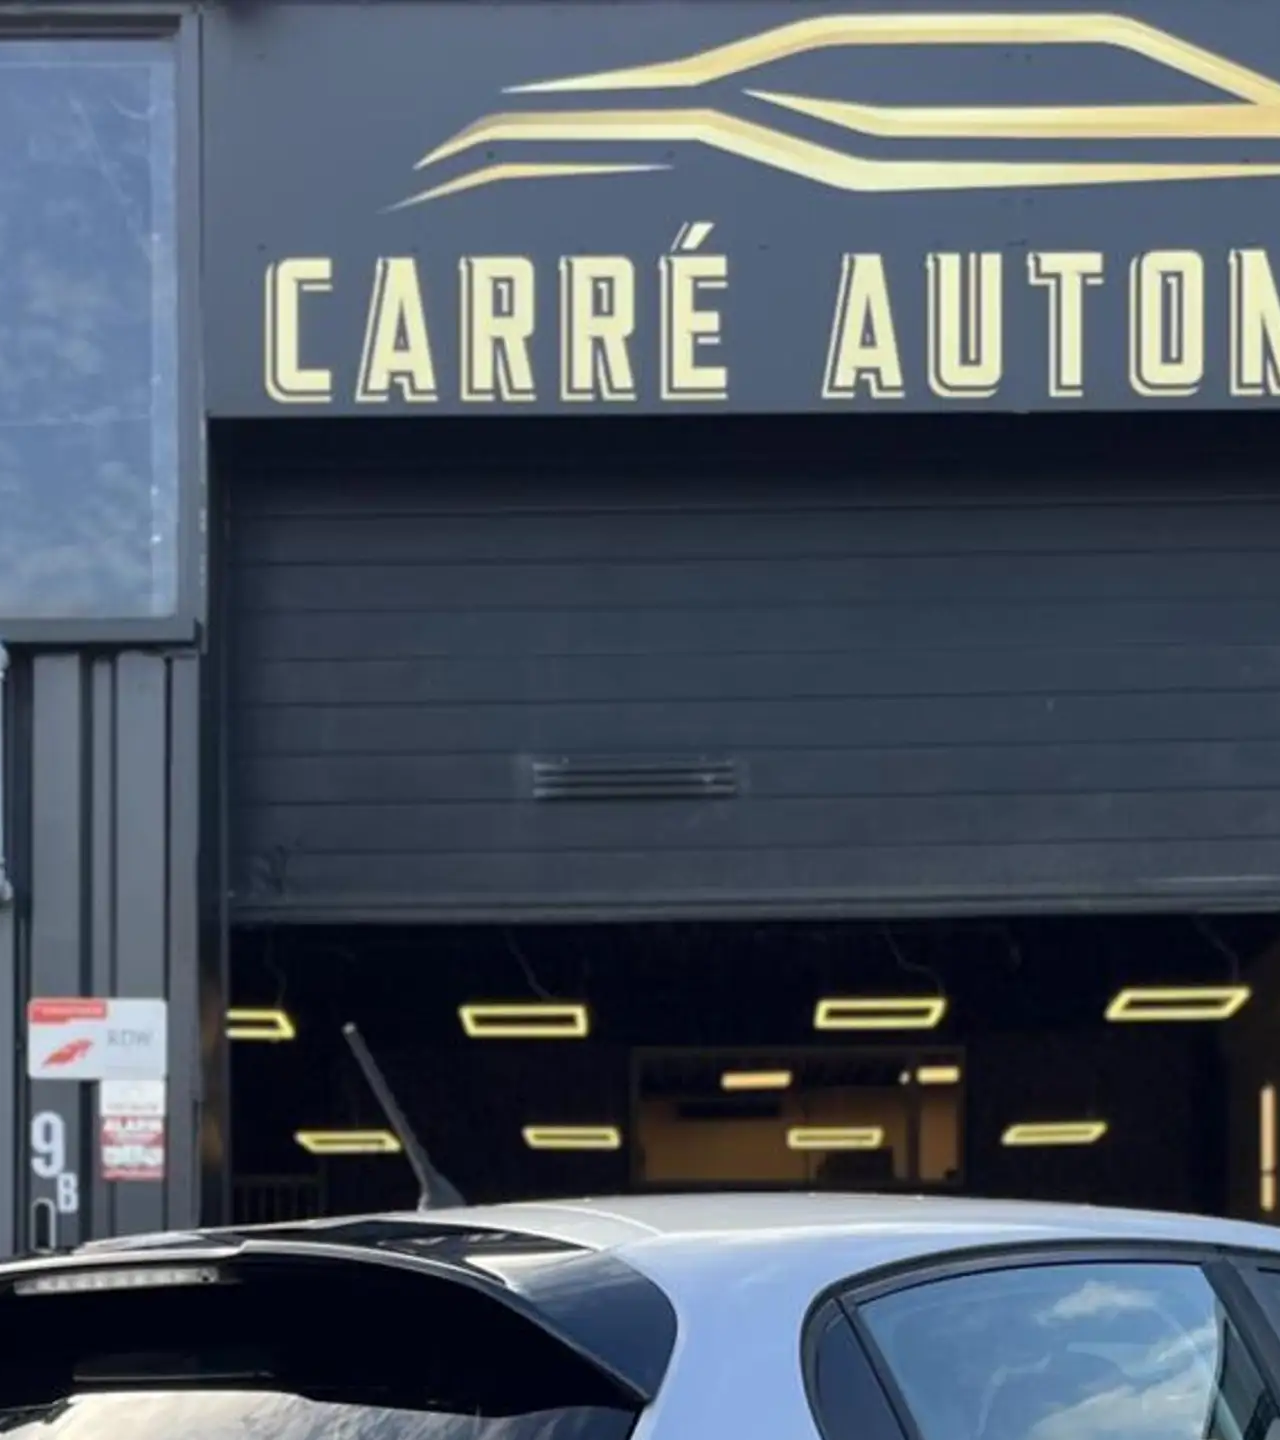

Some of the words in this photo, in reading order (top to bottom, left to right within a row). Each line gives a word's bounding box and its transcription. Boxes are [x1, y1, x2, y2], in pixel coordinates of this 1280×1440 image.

[263, 218, 730, 404] CARRÉ
[31, 1110, 64, 1179] 9
[57, 1172, 79, 1213] B
